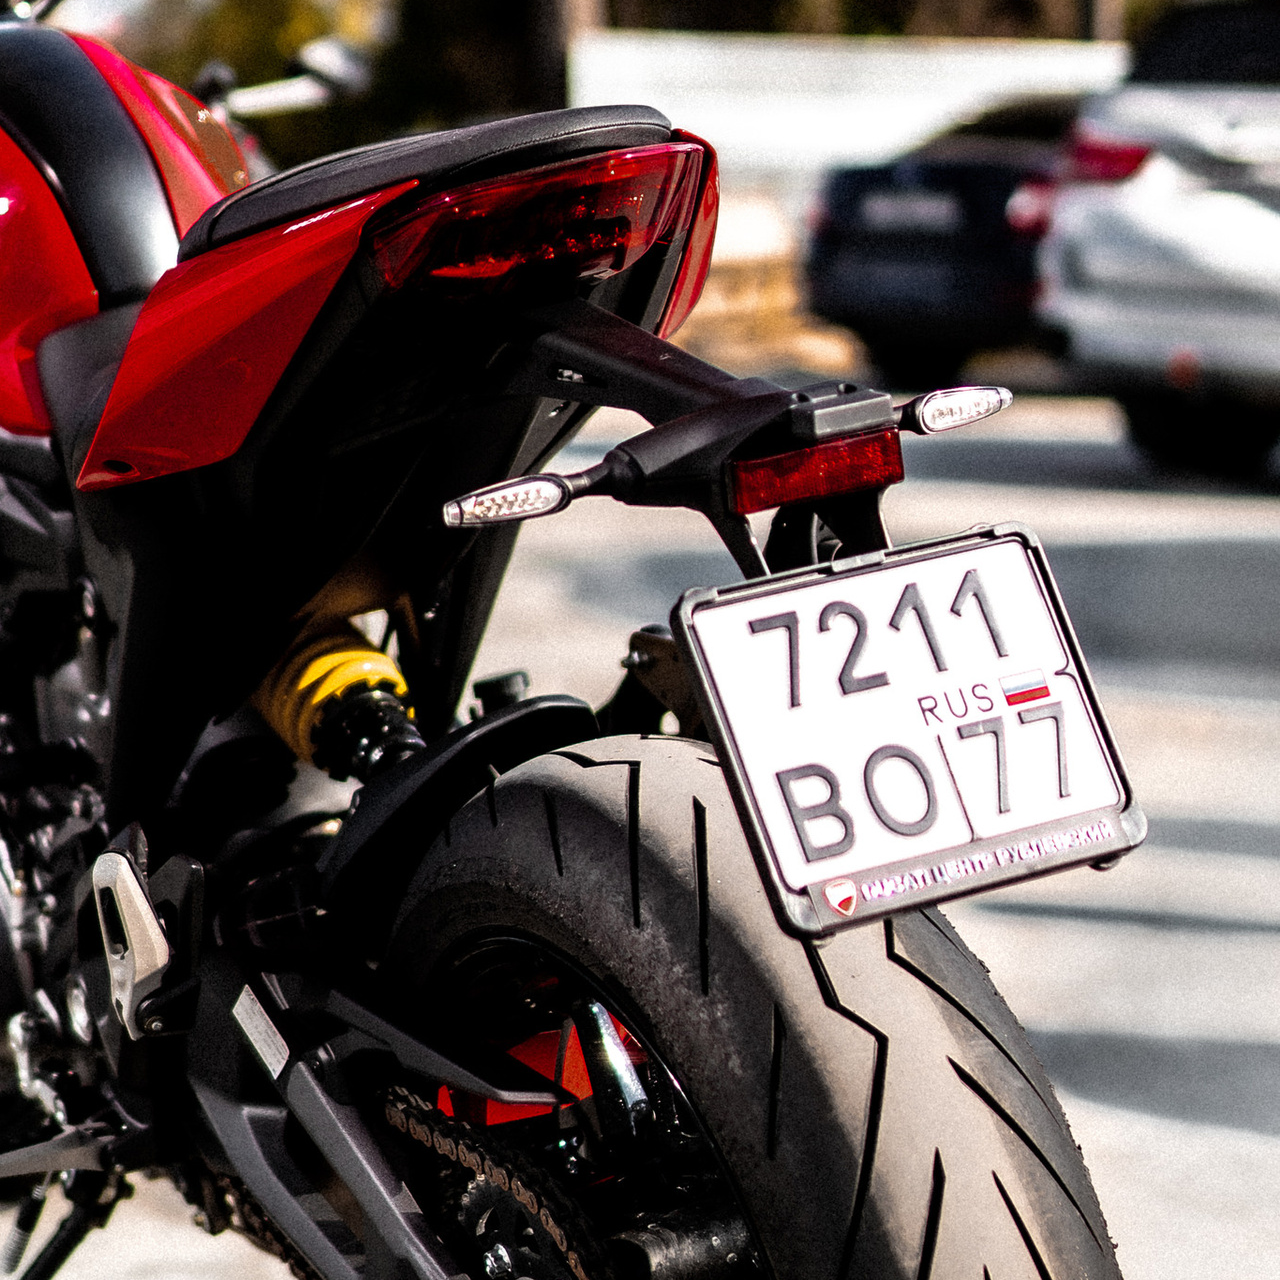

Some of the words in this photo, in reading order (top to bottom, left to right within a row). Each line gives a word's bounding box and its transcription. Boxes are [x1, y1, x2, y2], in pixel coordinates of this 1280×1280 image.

[748, 569, 1009, 709] 7211
[918, 684, 994, 725] RUS
[957, 702, 1071, 814] 77
